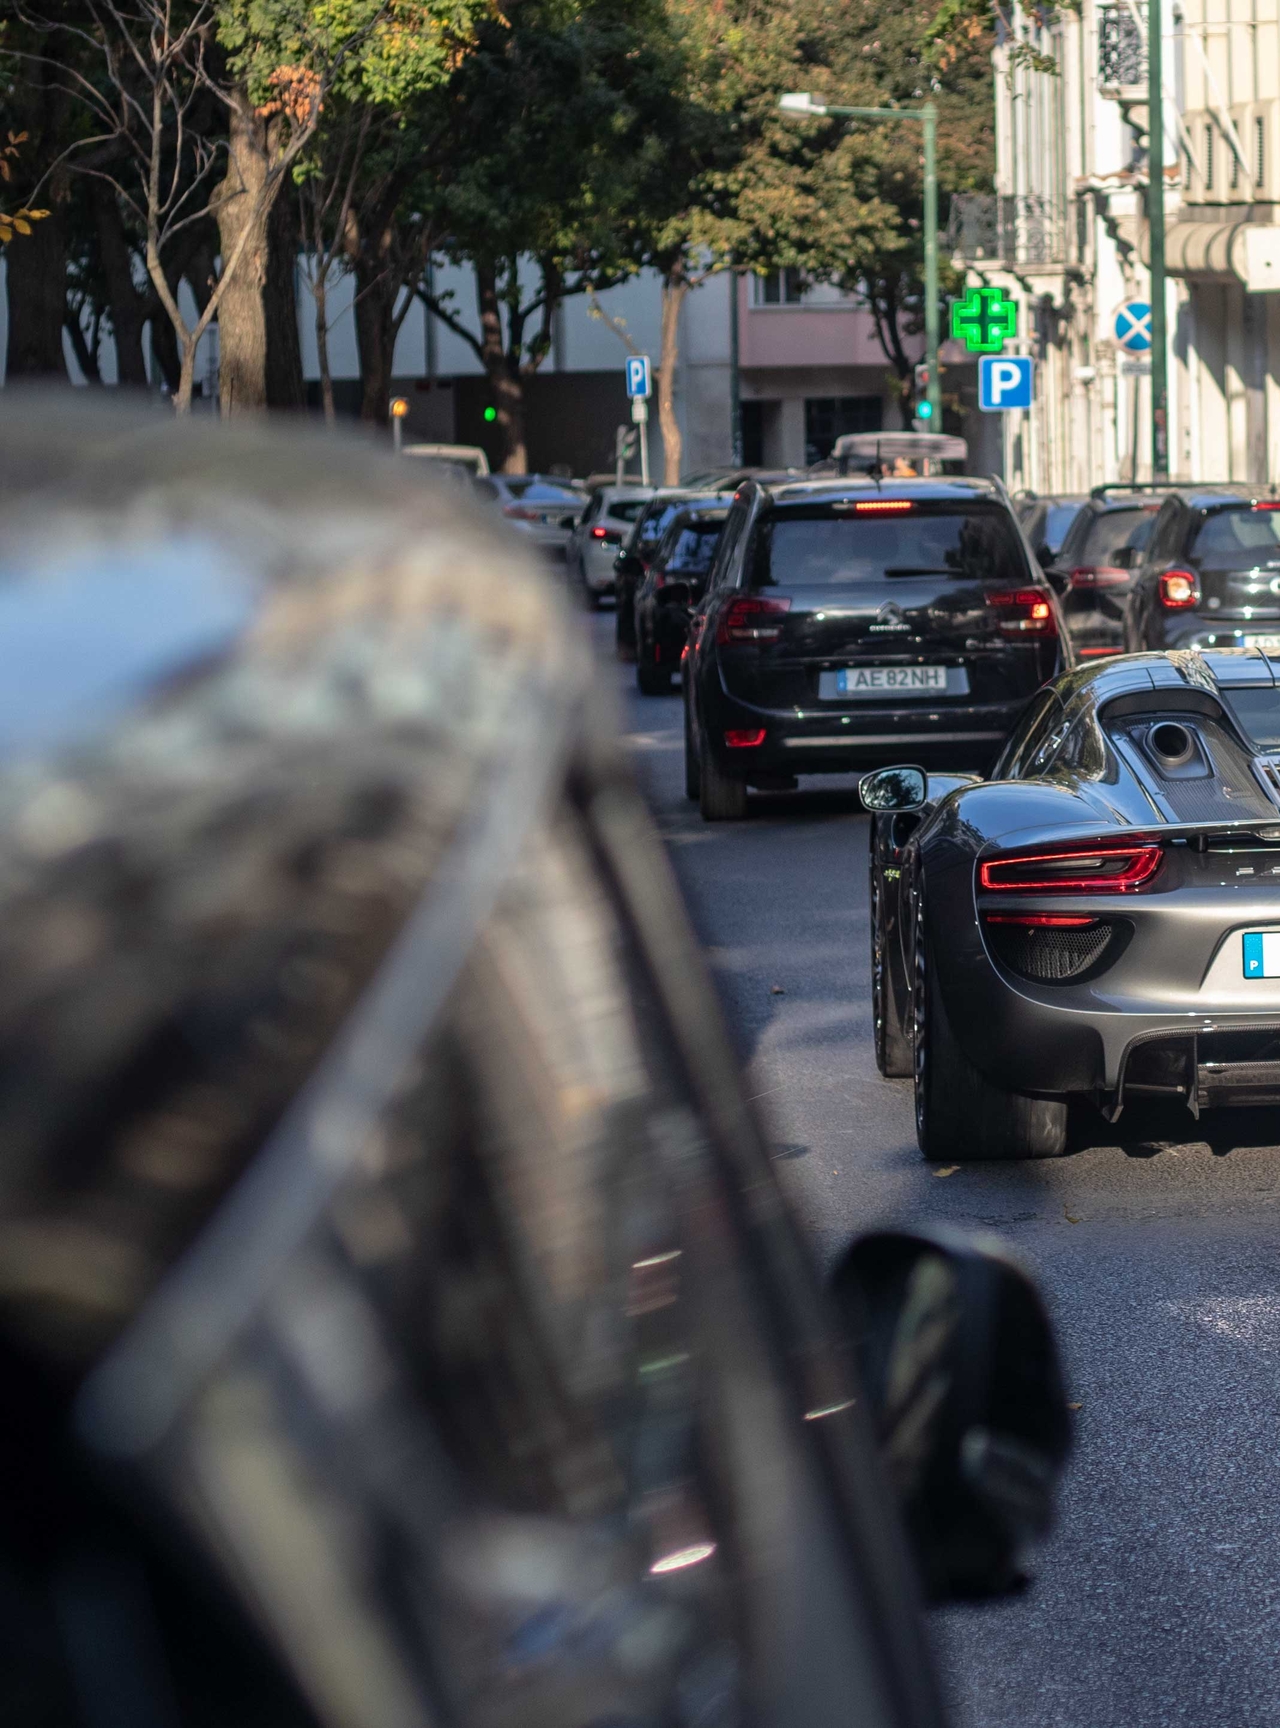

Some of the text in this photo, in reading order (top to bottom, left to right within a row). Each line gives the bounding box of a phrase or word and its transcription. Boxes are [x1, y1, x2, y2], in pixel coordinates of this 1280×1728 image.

[631, 361, 643, 393] P
[990, 362, 1022, 405] P
[855, 669, 939, 688] AE82NH
[1250, 960, 1259, 971] P
